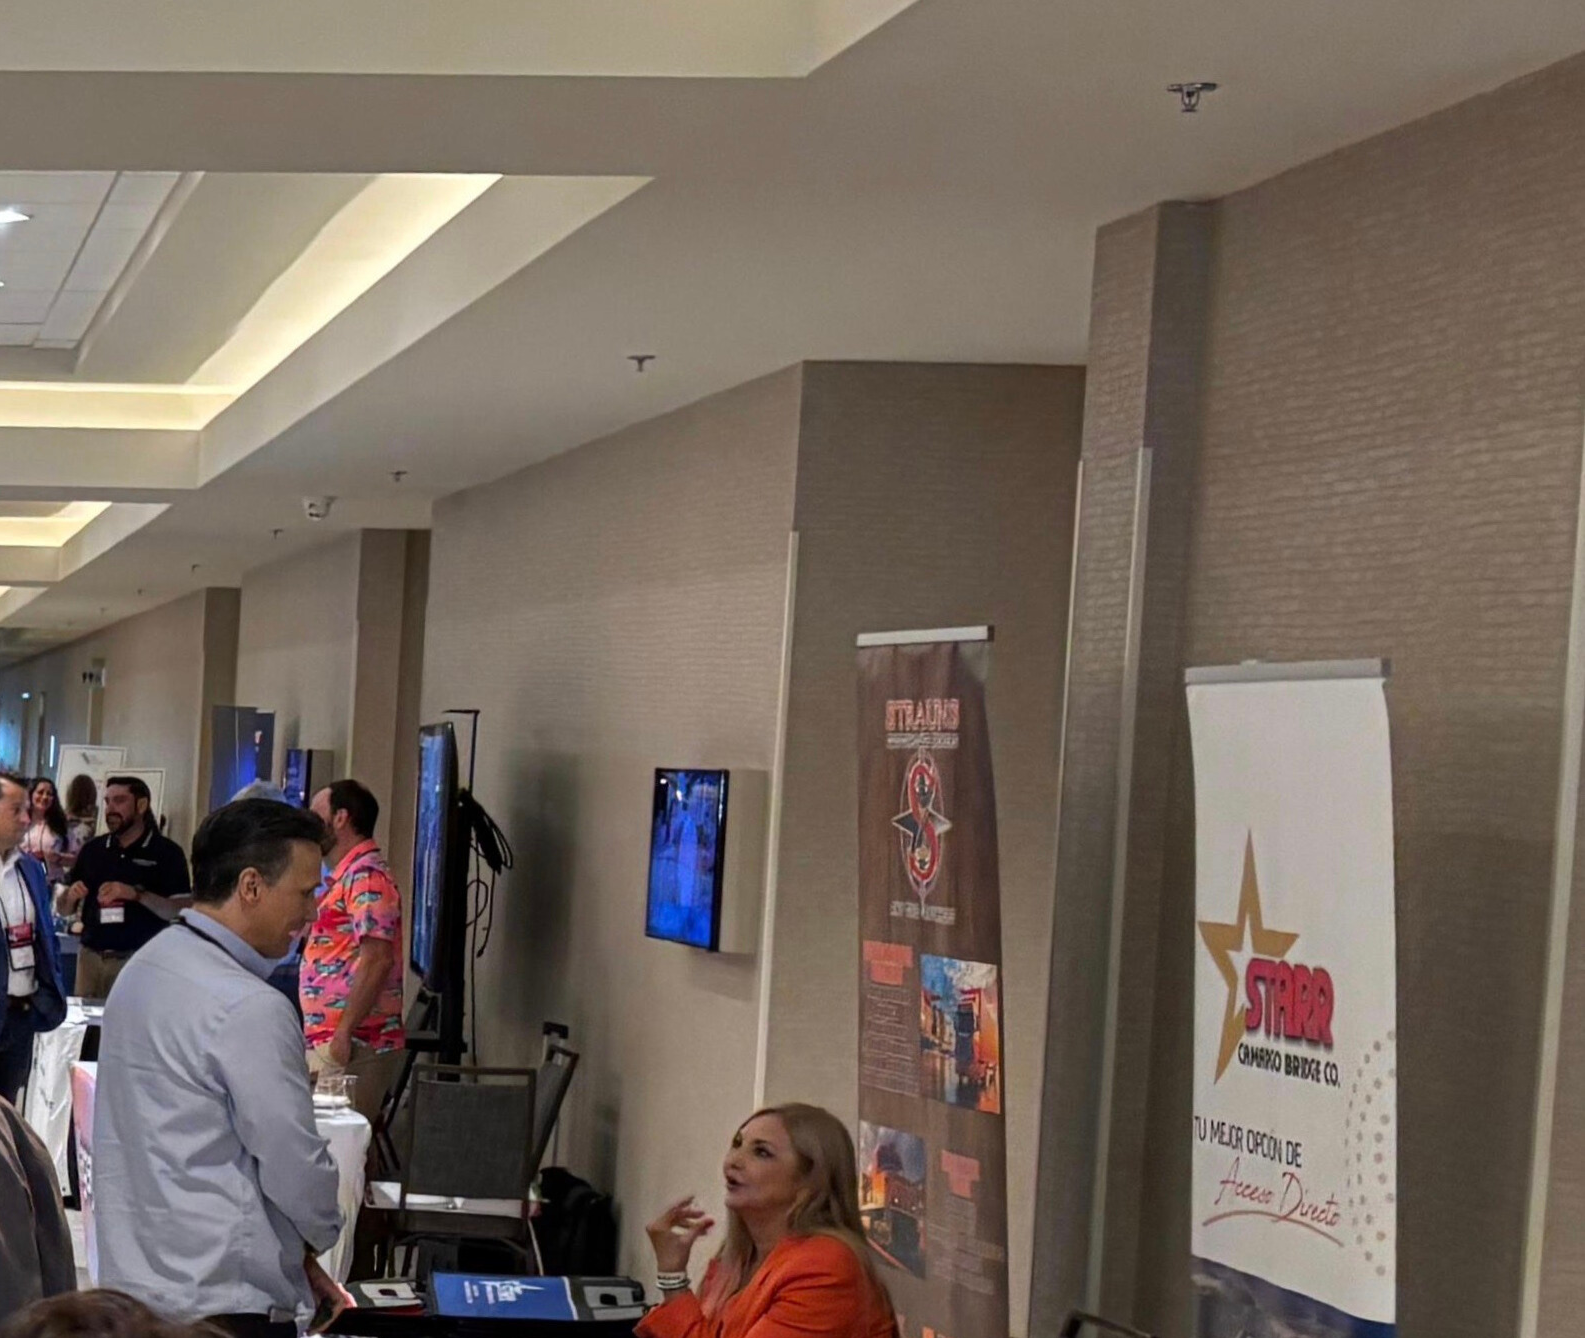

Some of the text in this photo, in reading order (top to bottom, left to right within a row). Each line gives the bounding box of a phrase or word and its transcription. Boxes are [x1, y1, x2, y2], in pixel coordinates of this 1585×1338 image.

[1245, 957, 1334, 1054] STARR
[1238, 1042, 1341, 1088] CAMARGO BRIDGE CO.
[1194, 1115, 1207, 1142] TU
[1210, 1119, 1243, 1153] MEJOR
[1286, 1140, 1303, 1168] DE
[1214, 1155, 1341, 1226] Acceso Directo
